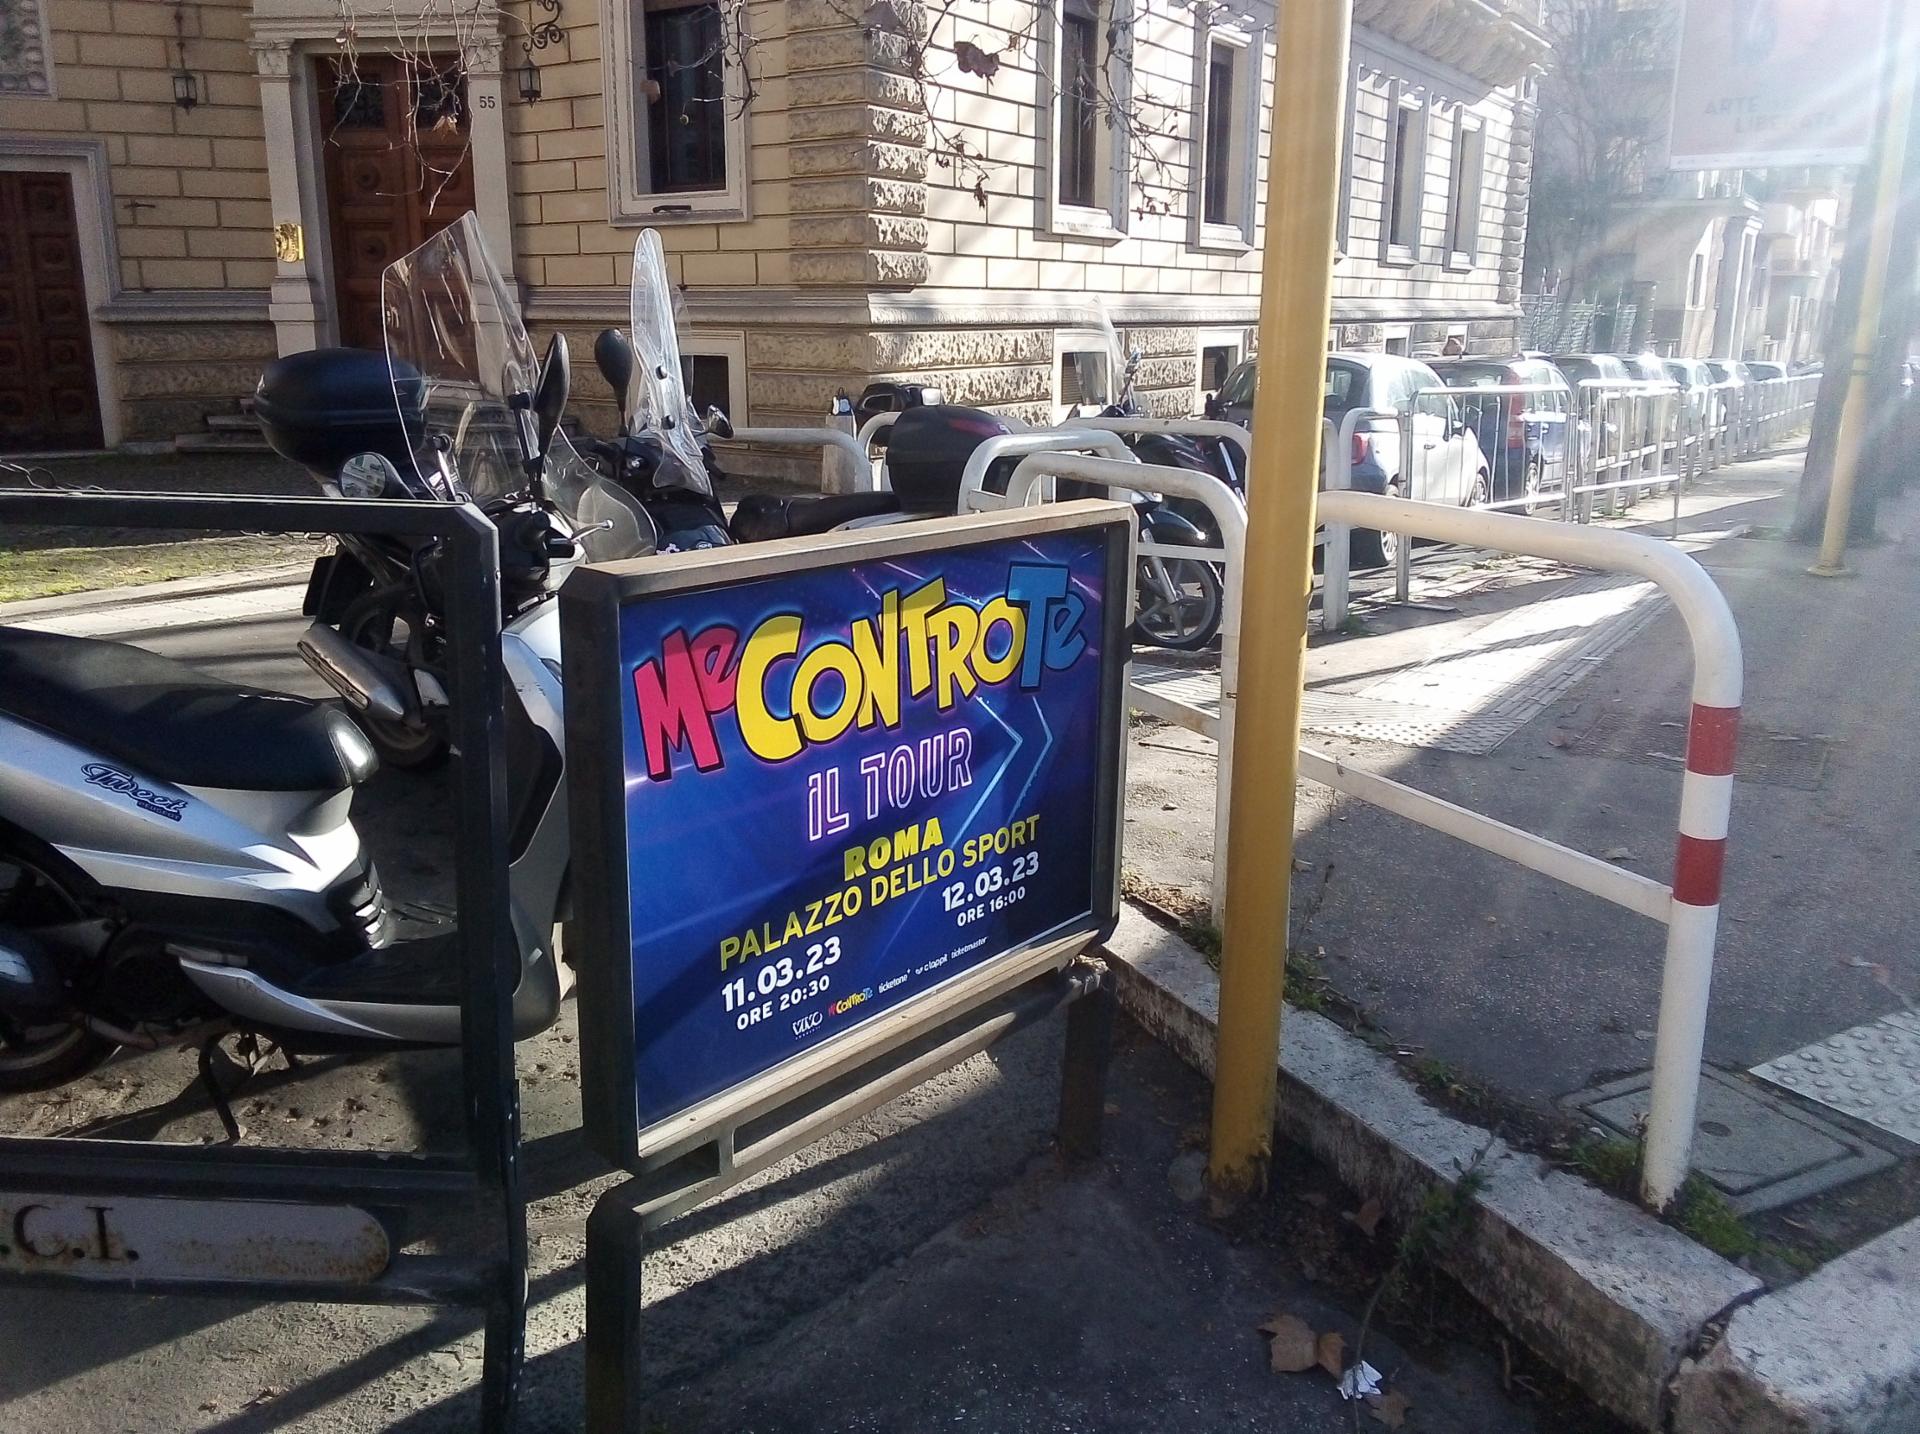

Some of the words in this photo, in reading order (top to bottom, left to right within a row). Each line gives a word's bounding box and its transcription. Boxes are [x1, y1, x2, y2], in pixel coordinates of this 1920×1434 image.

[479, 95, 496, 109] 55
[1703, 95, 1760, 115] ARTE
[81, 763, 187, 813] Tweet
[860, 727, 972, 820] TOUR
[844, 817, 943, 881] ROMA
[720, 886, 862, 971] PALAZZO
[871, 848, 955, 907] DELLO
[962, 814, 1040, 868] SPORT
[942, 851, 1039, 911] 12.03.23
[957, 904, 985, 926] ORE
[989, 886, 1026, 912] 16:00
[721, 936, 841, 1012] 11.03.23
[950, 936, 988, 959] ticketmaster
[737, 1001, 773, 1030] ORE
[779, 975, 830, 1011] 20:30
